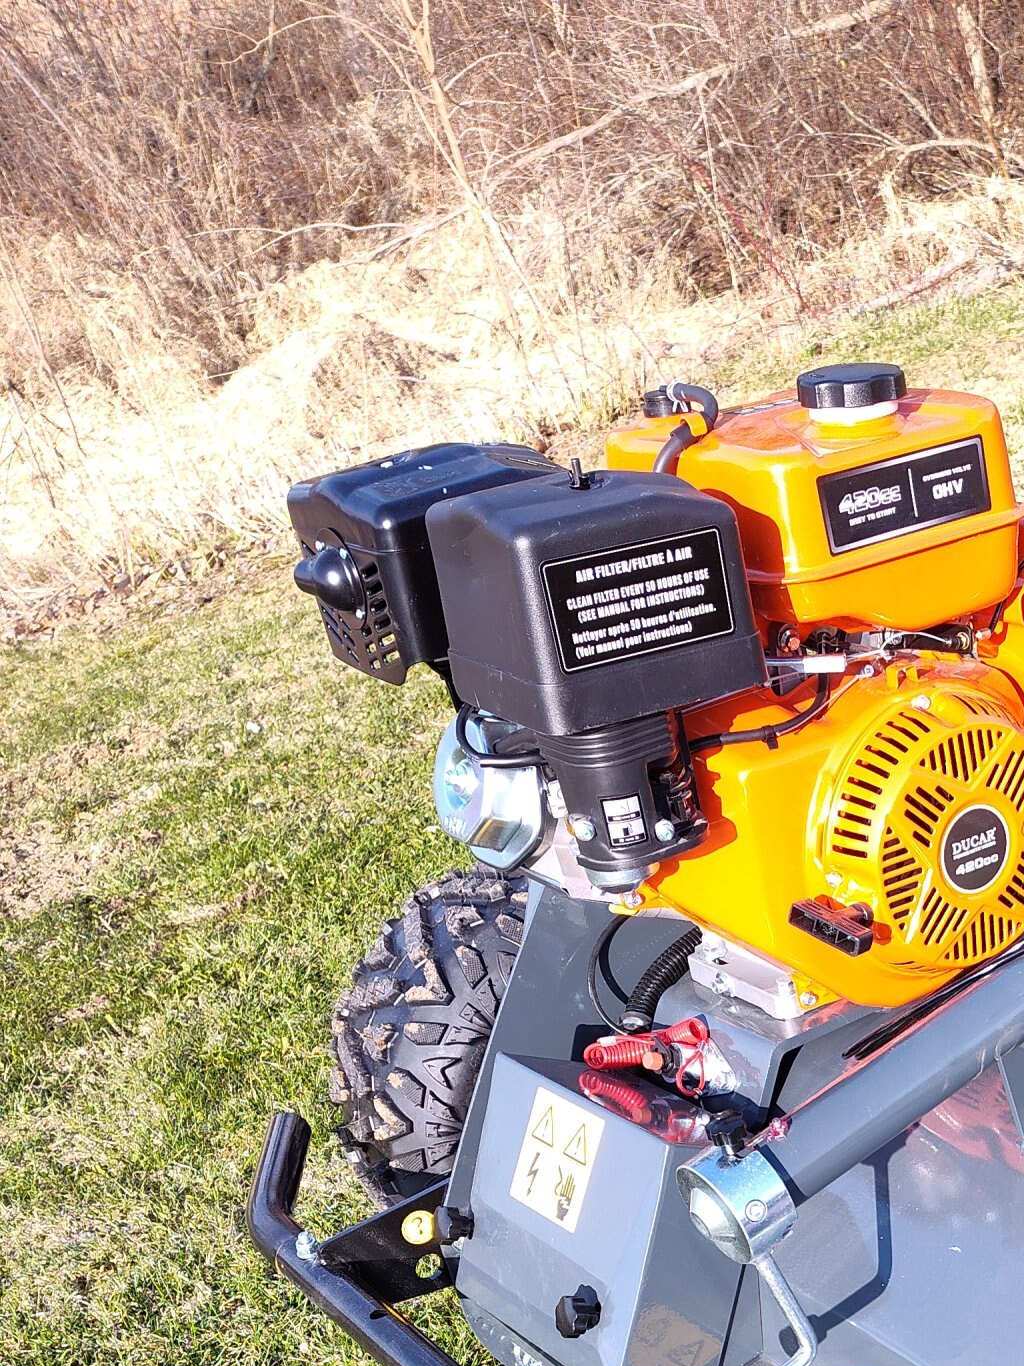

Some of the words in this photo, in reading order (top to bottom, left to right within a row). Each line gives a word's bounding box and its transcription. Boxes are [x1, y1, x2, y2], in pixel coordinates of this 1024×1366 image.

[838, 485, 901, 514] 420cc
[932, 478, 963, 499] OHV
[575, 567, 595, 583] AIR
[594, 552, 665, 579] FILTER/FILTRE
[665, 548, 675, 563] À
[674, 546, 693, 561] AIR
[566, 594, 594, 610] CLEAN
[593, 588, 620, 604] FILTER
[620, 582, 644, 598] EVERY
[645, 580, 656, 592] 50
[656, 574, 683, 590] HOURS
[683, 571, 693, 584] OF
[694, 568, 710, 581] USE
[577, 608, 597, 624] (SEE
[597, 601, 630, 618] MANUAL
[630, 597, 646, 610] FOR
[646, 583, 705, 607] INSTRUCTIONS)
[630, 618, 641, 630] 50
[951, 828, 996, 855] DUCAR
